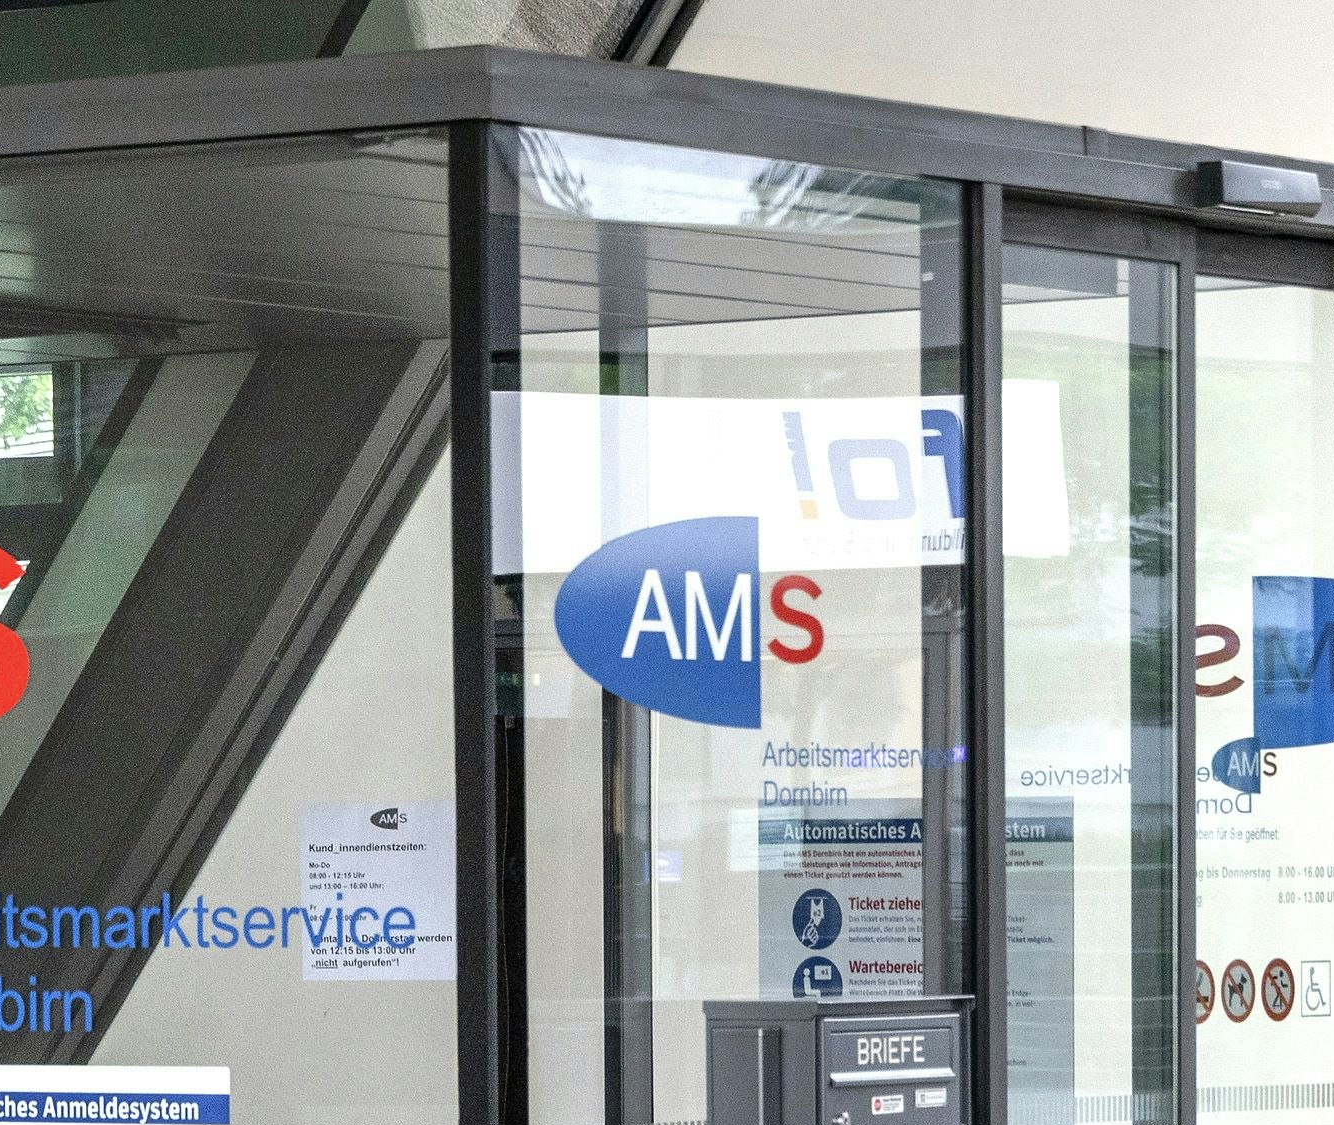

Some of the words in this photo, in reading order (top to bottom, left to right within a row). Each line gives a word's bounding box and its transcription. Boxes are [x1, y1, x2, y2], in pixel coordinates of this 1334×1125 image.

[621, 569, 826, 665] AMS
[1227, 751, 1278, 777] AMS
[763, 781, 847, 806] Dornbirn
[378, 813, 407, 824] AMS
[783, 823, 906, 840] Automatisches
[1217, 828, 1228, 840] für
[1230, 829, 1242, 840] Sie
[309, 843, 427, 854] Kund_innendienstzeiten:
[804, 871, 824, 879] Ticket
[852, 871, 876, 879] werden
[1206, 868, 1219, 878] bis
[1222, 867, 1271, 881] Donnerstag
[848, 897, 885, 911] Ticket
[888, 897, 922, 911] ziehe
[330, 947, 353, 955] 12:15
[849, 961, 923, 974] Wartebereic
[857, 1036, 925, 1065] BRIEFE
[43, 1096, 199, 1125] Anmeldesystem
